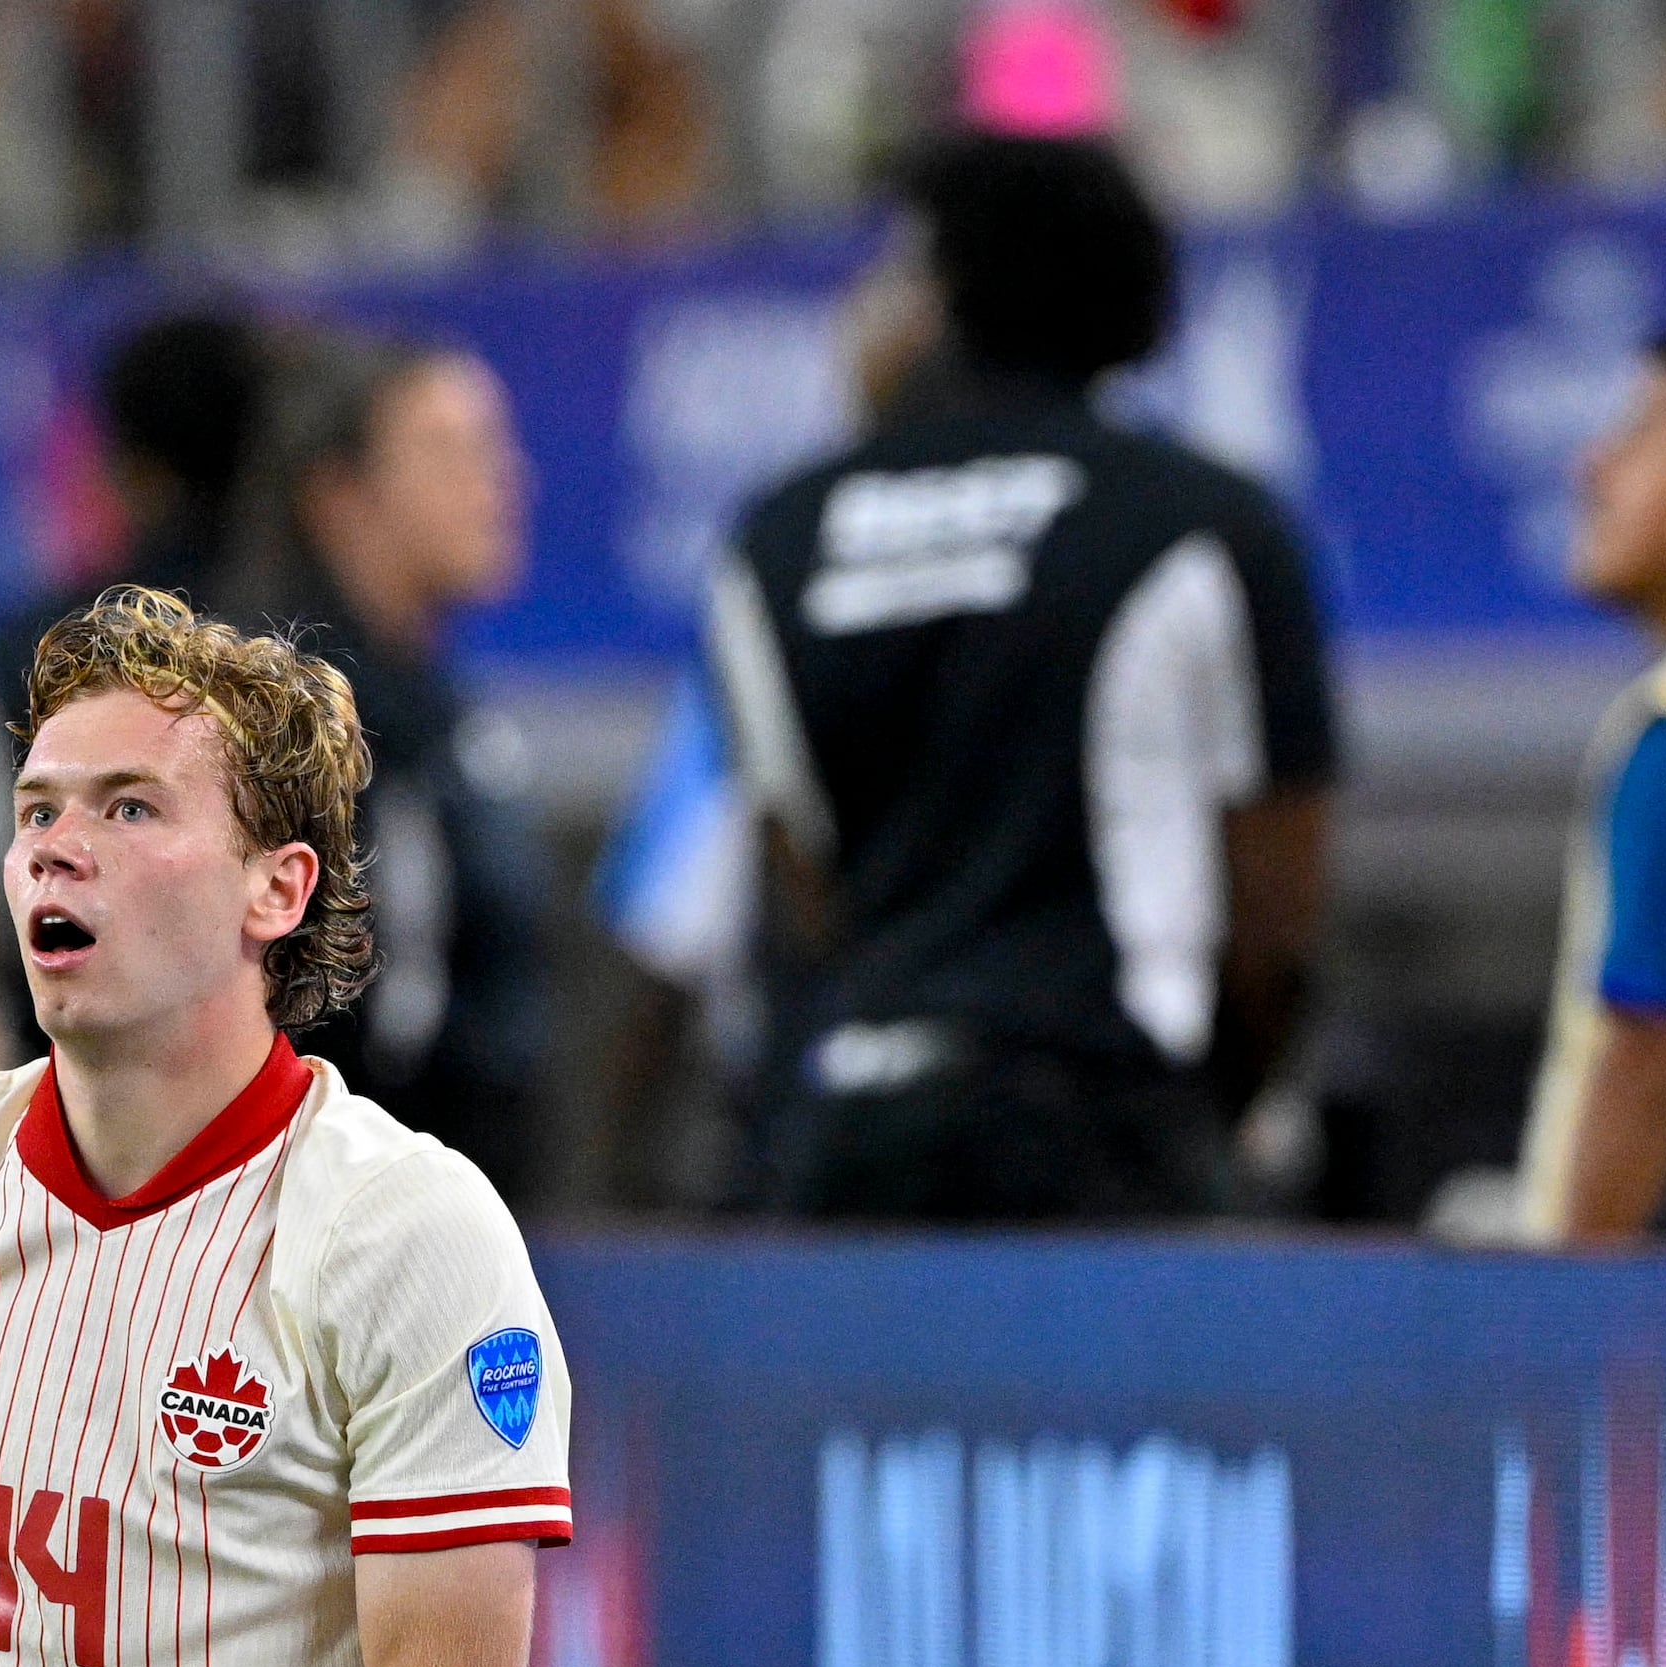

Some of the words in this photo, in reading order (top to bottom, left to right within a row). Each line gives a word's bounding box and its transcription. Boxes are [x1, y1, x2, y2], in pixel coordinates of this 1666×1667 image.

[483, 1361, 535, 1383] ROCKING
[483, 1384, 498, 1393] THE
[500, 1377, 536, 1390] CONTINENT
